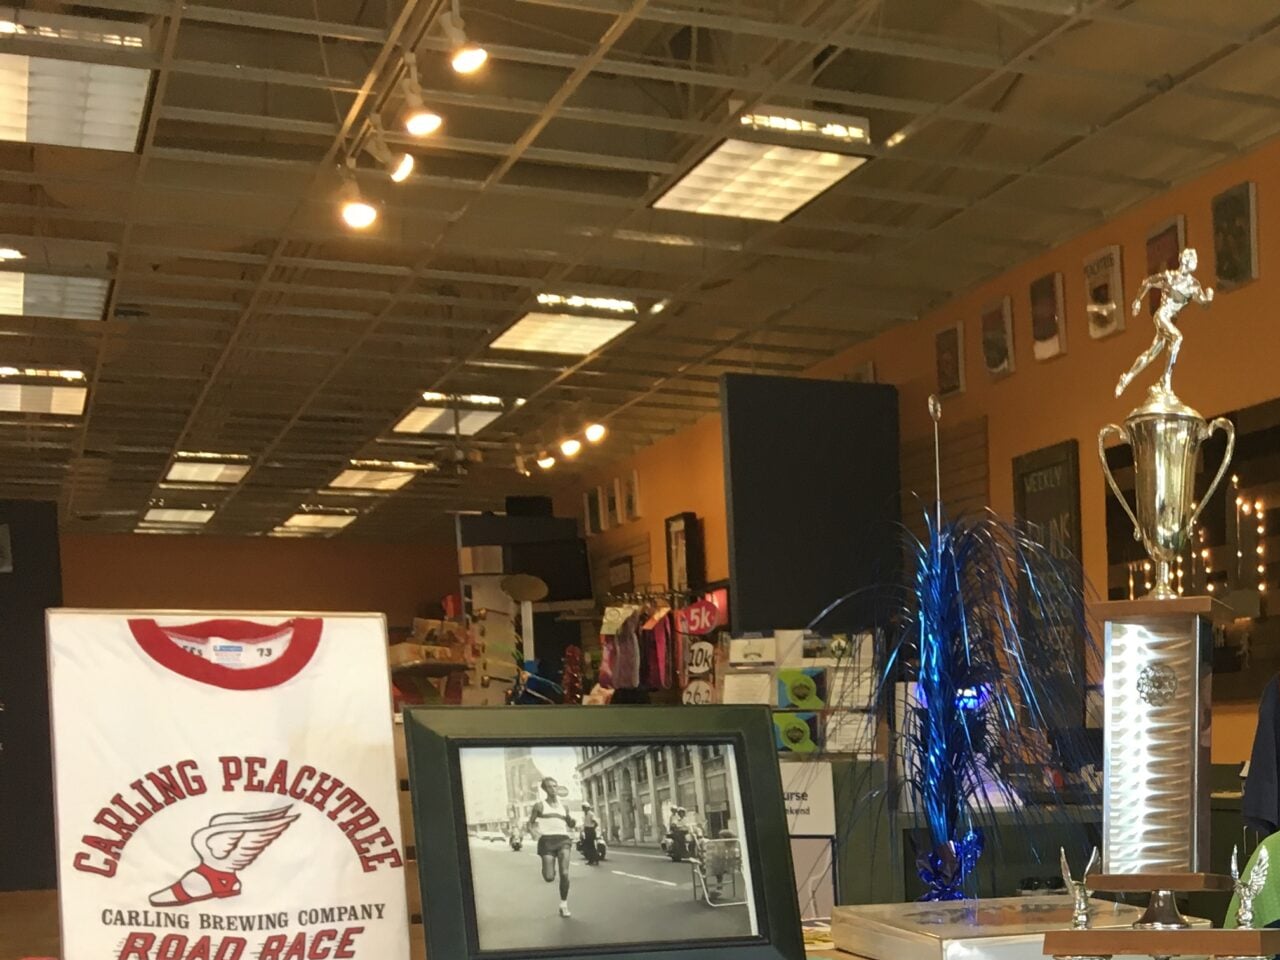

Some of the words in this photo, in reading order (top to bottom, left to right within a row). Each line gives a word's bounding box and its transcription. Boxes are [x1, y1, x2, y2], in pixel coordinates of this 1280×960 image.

[689, 605, 711, 631] 5k
[74, 758, 208, 879] CARLING
[218, 755, 402, 874] PEACHTREE
[101, 908, 190, 930] CARLING
[199, 911, 289, 932] BREWING
[298, 903, 386, 927] COMPANY
